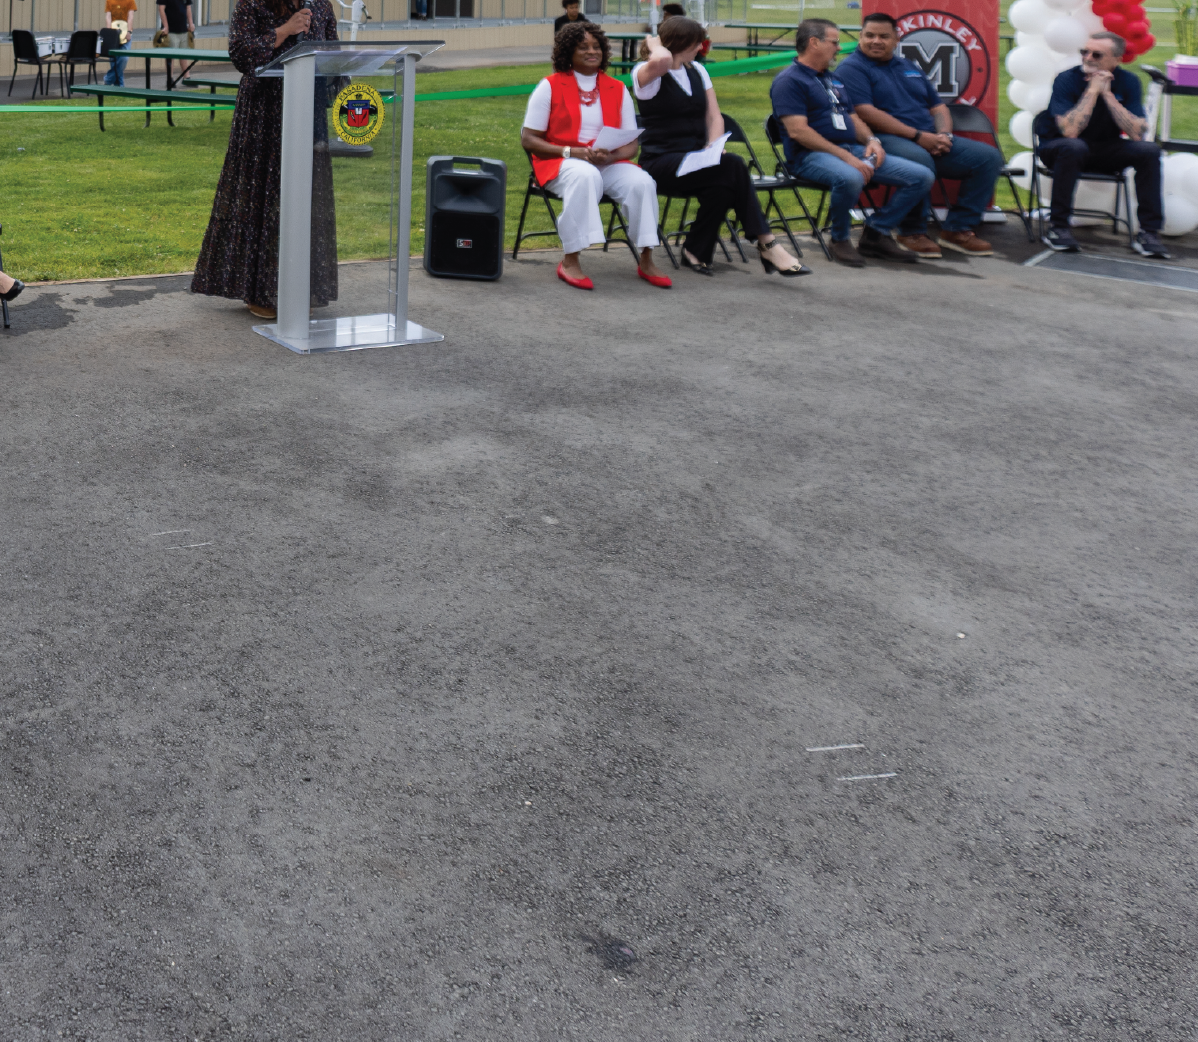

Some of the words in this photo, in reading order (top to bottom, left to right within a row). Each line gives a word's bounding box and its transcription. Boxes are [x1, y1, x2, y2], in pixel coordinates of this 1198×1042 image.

[896, 13, 982, 51] cKINLEY
[339, 85, 376, 101] PASADENA
[340, 131, 376, 143] CALIFORNIA
